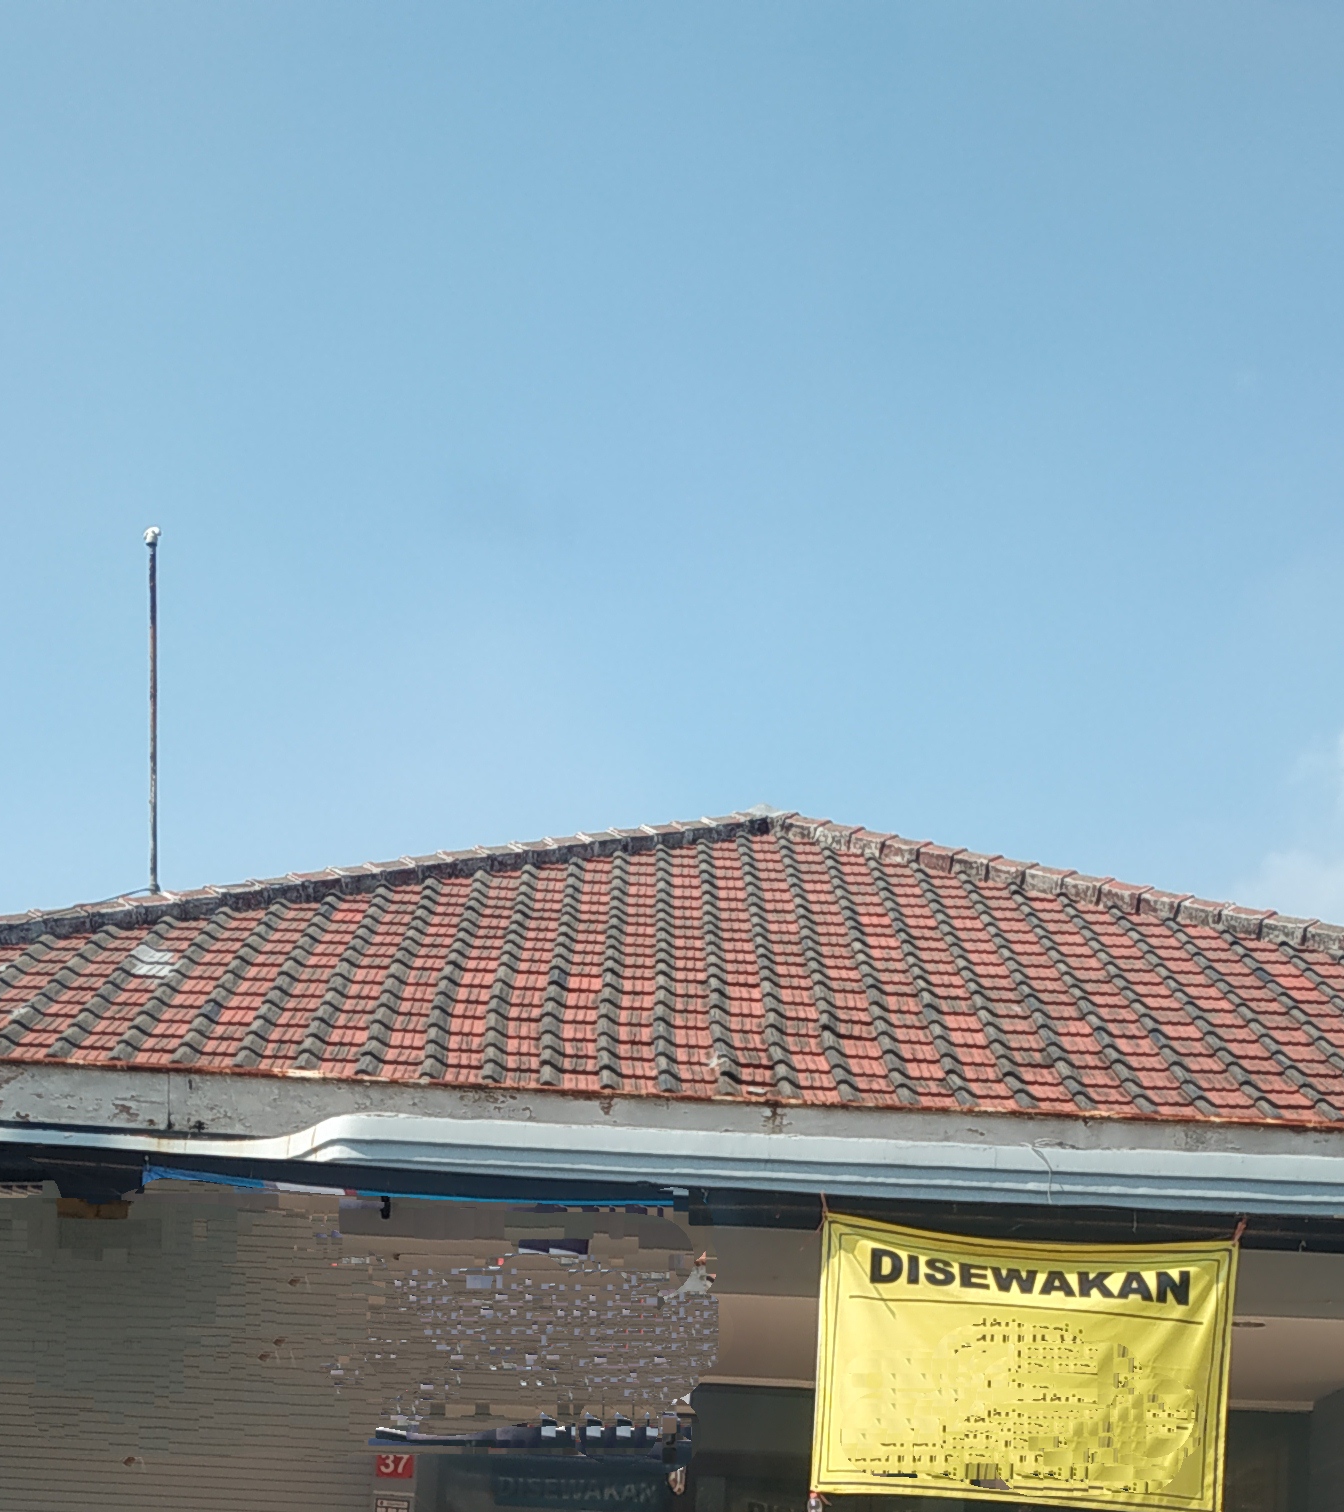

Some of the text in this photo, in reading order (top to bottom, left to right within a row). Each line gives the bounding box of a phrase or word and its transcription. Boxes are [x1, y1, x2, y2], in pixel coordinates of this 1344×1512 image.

[870, 1247, 1191, 1306] DISEWAKAN
[380, 1454, 410, 1475] 37
[496, 1476, 657, 1504] DISEWAKAN
